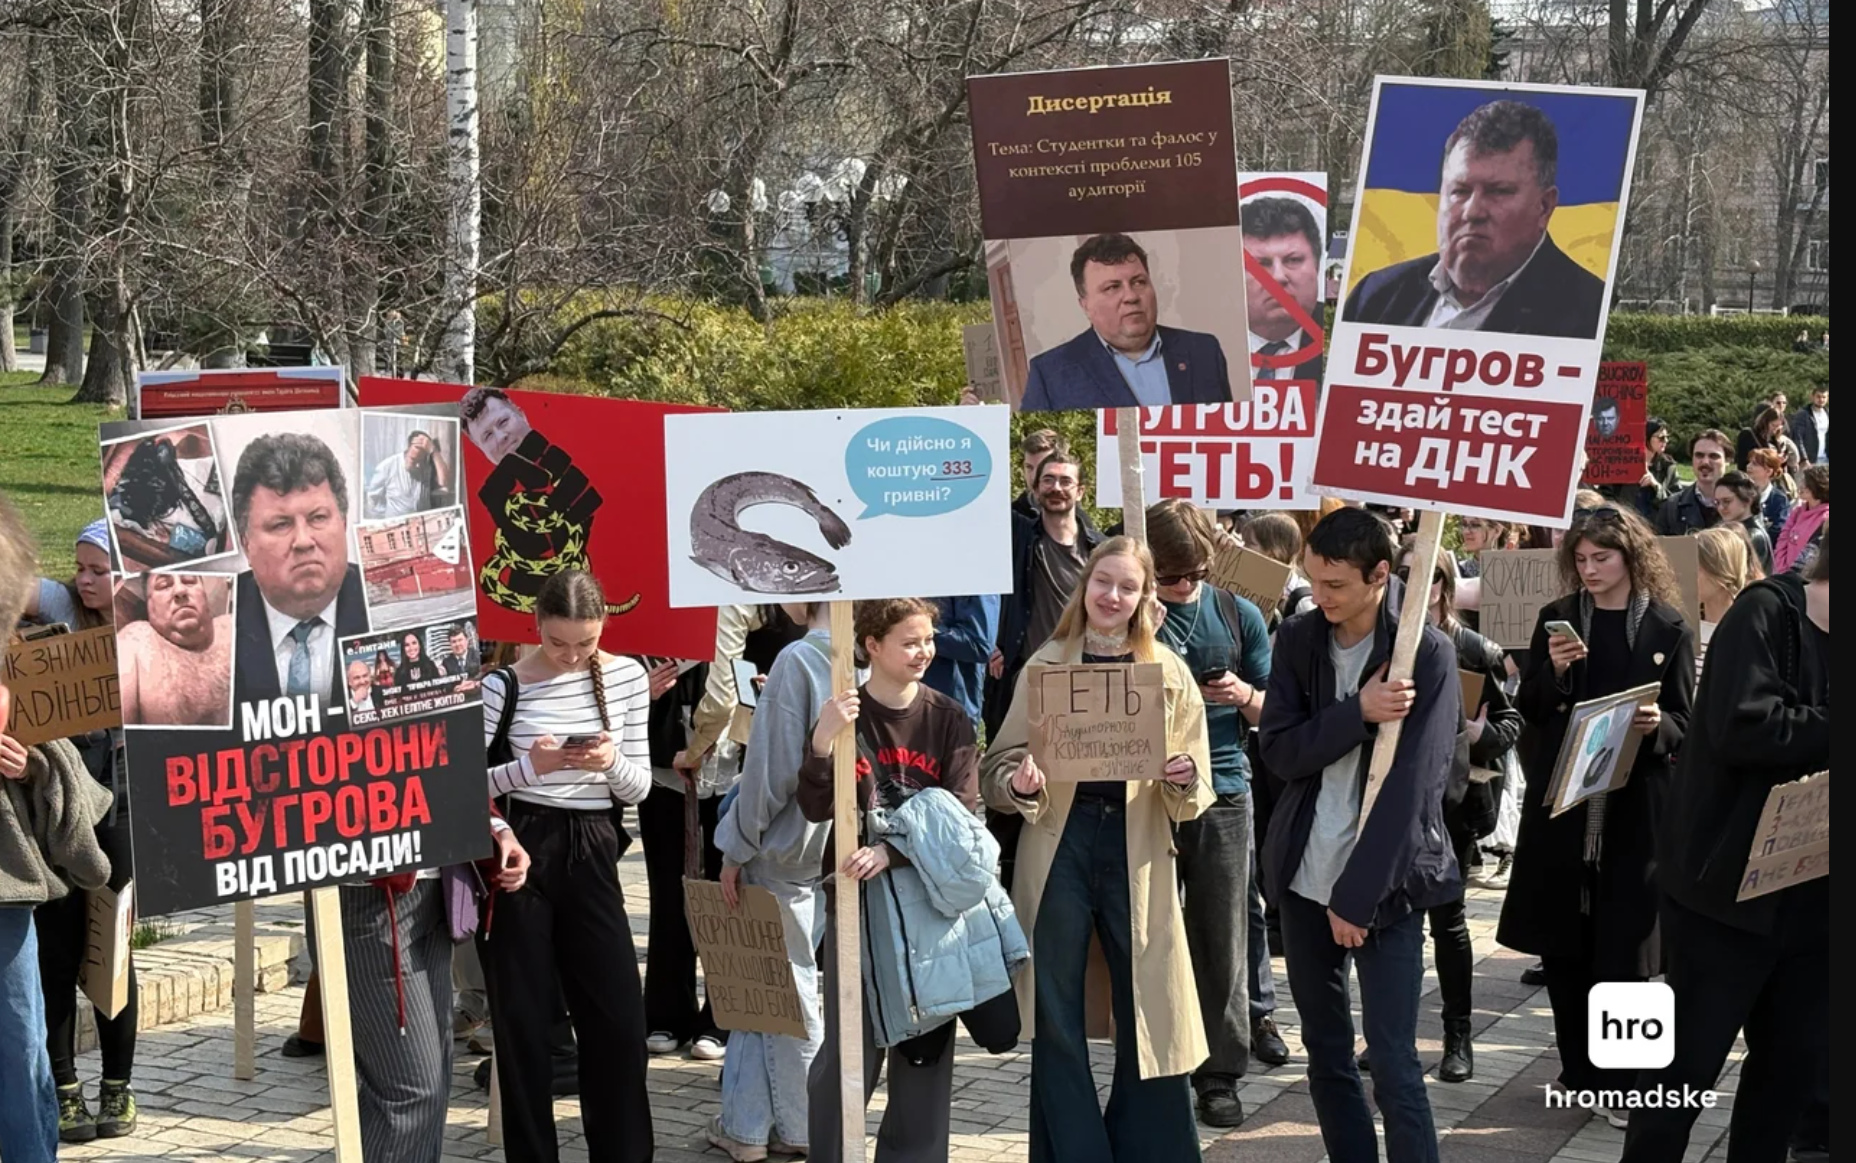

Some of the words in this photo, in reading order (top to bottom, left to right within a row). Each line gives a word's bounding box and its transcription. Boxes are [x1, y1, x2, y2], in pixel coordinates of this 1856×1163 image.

[1026, 86, 1172, 117] Дисертація
[988, 142, 1034, 156] Тема:
[1036, 137, 1125, 157] Студентки
[1131, 135, 1147, 148] та
[1151, 130, 1204, 149] фалос
[1208, 130, 1218, 146] у
[1008, 159, 1086, 179] контексті
[1090, 155, 1171, 176] проблеми
[1175, 152, 1203, 167] 105
[1068, 180, 1146, 201] аудиторії
[1354, 333, 1545, 391] Бугров
[1356, 396, 1453, 433] здай
[1459, 408, 1549, 439] тест
[867, 438, 891, 452] Чи
[895, 435, 956, 455] дійсно
[961, 437, 972, 449] я
[1354, 440, 1402, 468] на
[1404, 436, 1538, 490] ДНК
[867, 463, 937, 480] коштую
[942, 460, 972, 475] 333
[1140, 441, 1295, 500] ЕТЬ!
[883, 486, 951, 507] гривні?
[1041, 669, 1142, 716] ГЕТЬ
[241, 696, 321, 742] МОН
[165, 720, 449, 806] ВІДСТОРОНИ
[201, 775, 431, 860] БУГРОВА
[215, 854, 277, 897] ВІД
[283, 830, 422, 885] ПОСАДИ!
